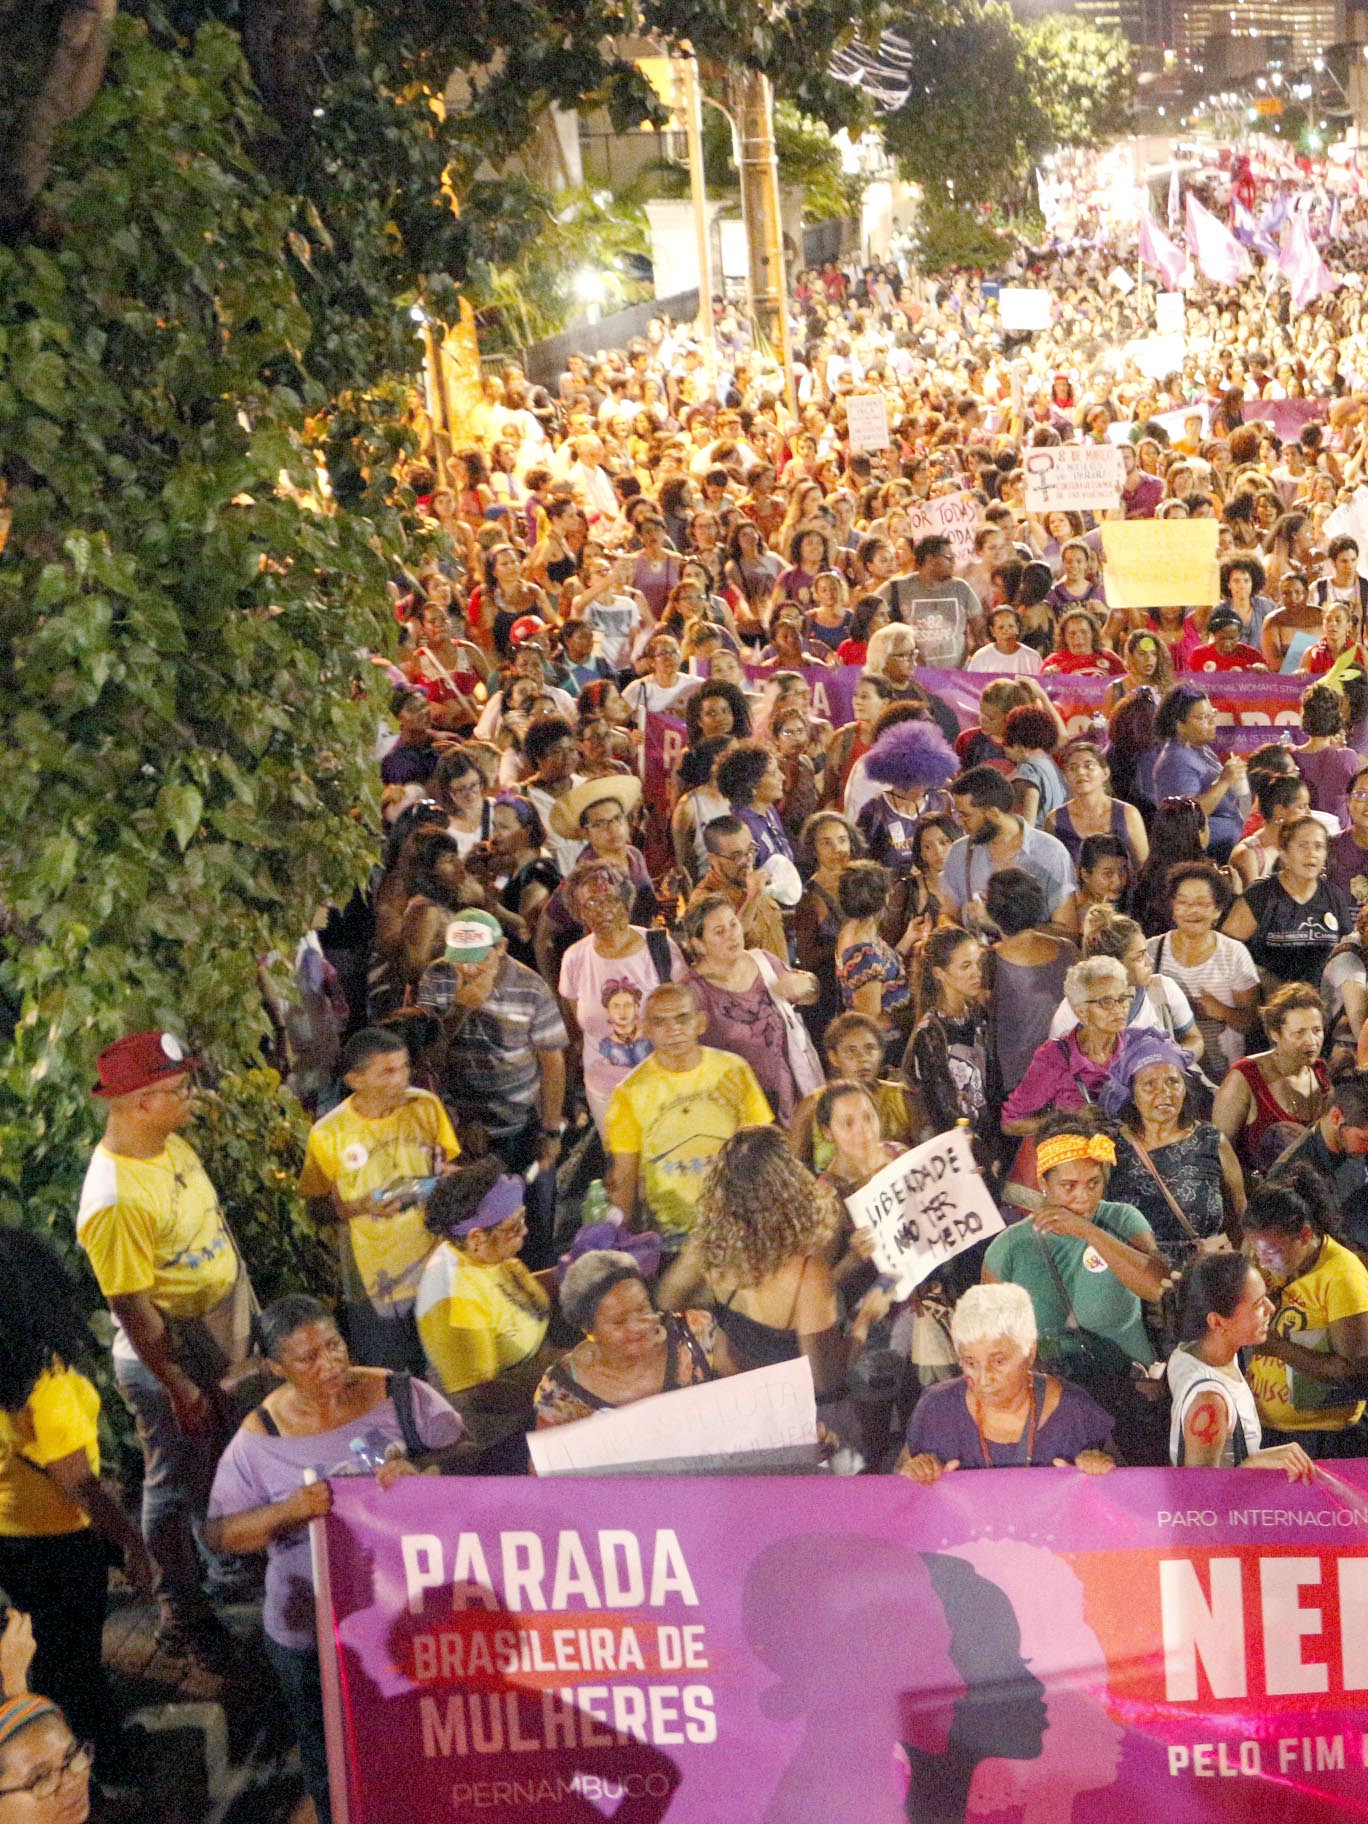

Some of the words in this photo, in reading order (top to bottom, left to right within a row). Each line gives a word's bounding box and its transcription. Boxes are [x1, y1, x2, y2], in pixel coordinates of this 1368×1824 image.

[865, 1146, 960, 1229] LIBERDADE
[921, 1190, 957, 1229] TER
[927, 1211, 983, 1259] MEDO
[1157, 1509, 1218, 1529] PARO
[401, 1529, 699, 1614] PARADA
[413, 1626, 645, 1681] BRASILEIRA
[657, 1625, 709, 1670] DE
[420, 1685, 718, 1758] MULHERES
[1168, 1740, 1262, 1778] PELO
[1278, 1734, 1345, 1774] FIM
[452, 1770, 669, 1808] PERNAMBUCO
